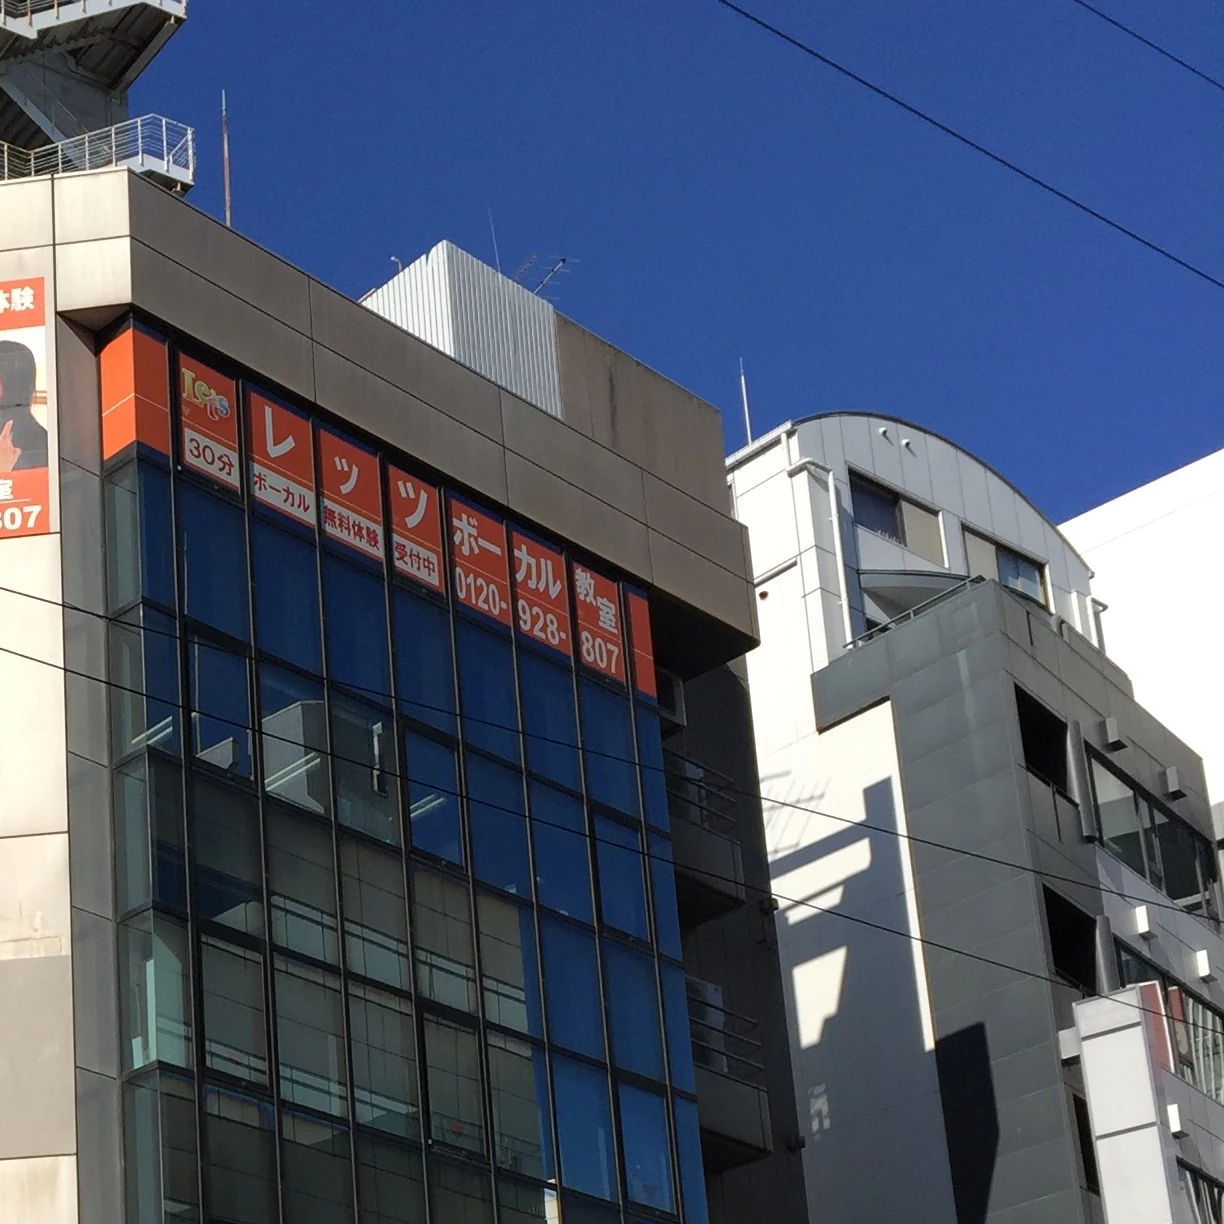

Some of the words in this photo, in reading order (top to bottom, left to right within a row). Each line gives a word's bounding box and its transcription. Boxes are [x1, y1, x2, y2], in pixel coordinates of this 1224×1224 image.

[188, 436, 235, 477] 30分
[253, 473, 312, 515] ボーカル
[394, 540, 438, 577] 受付中
